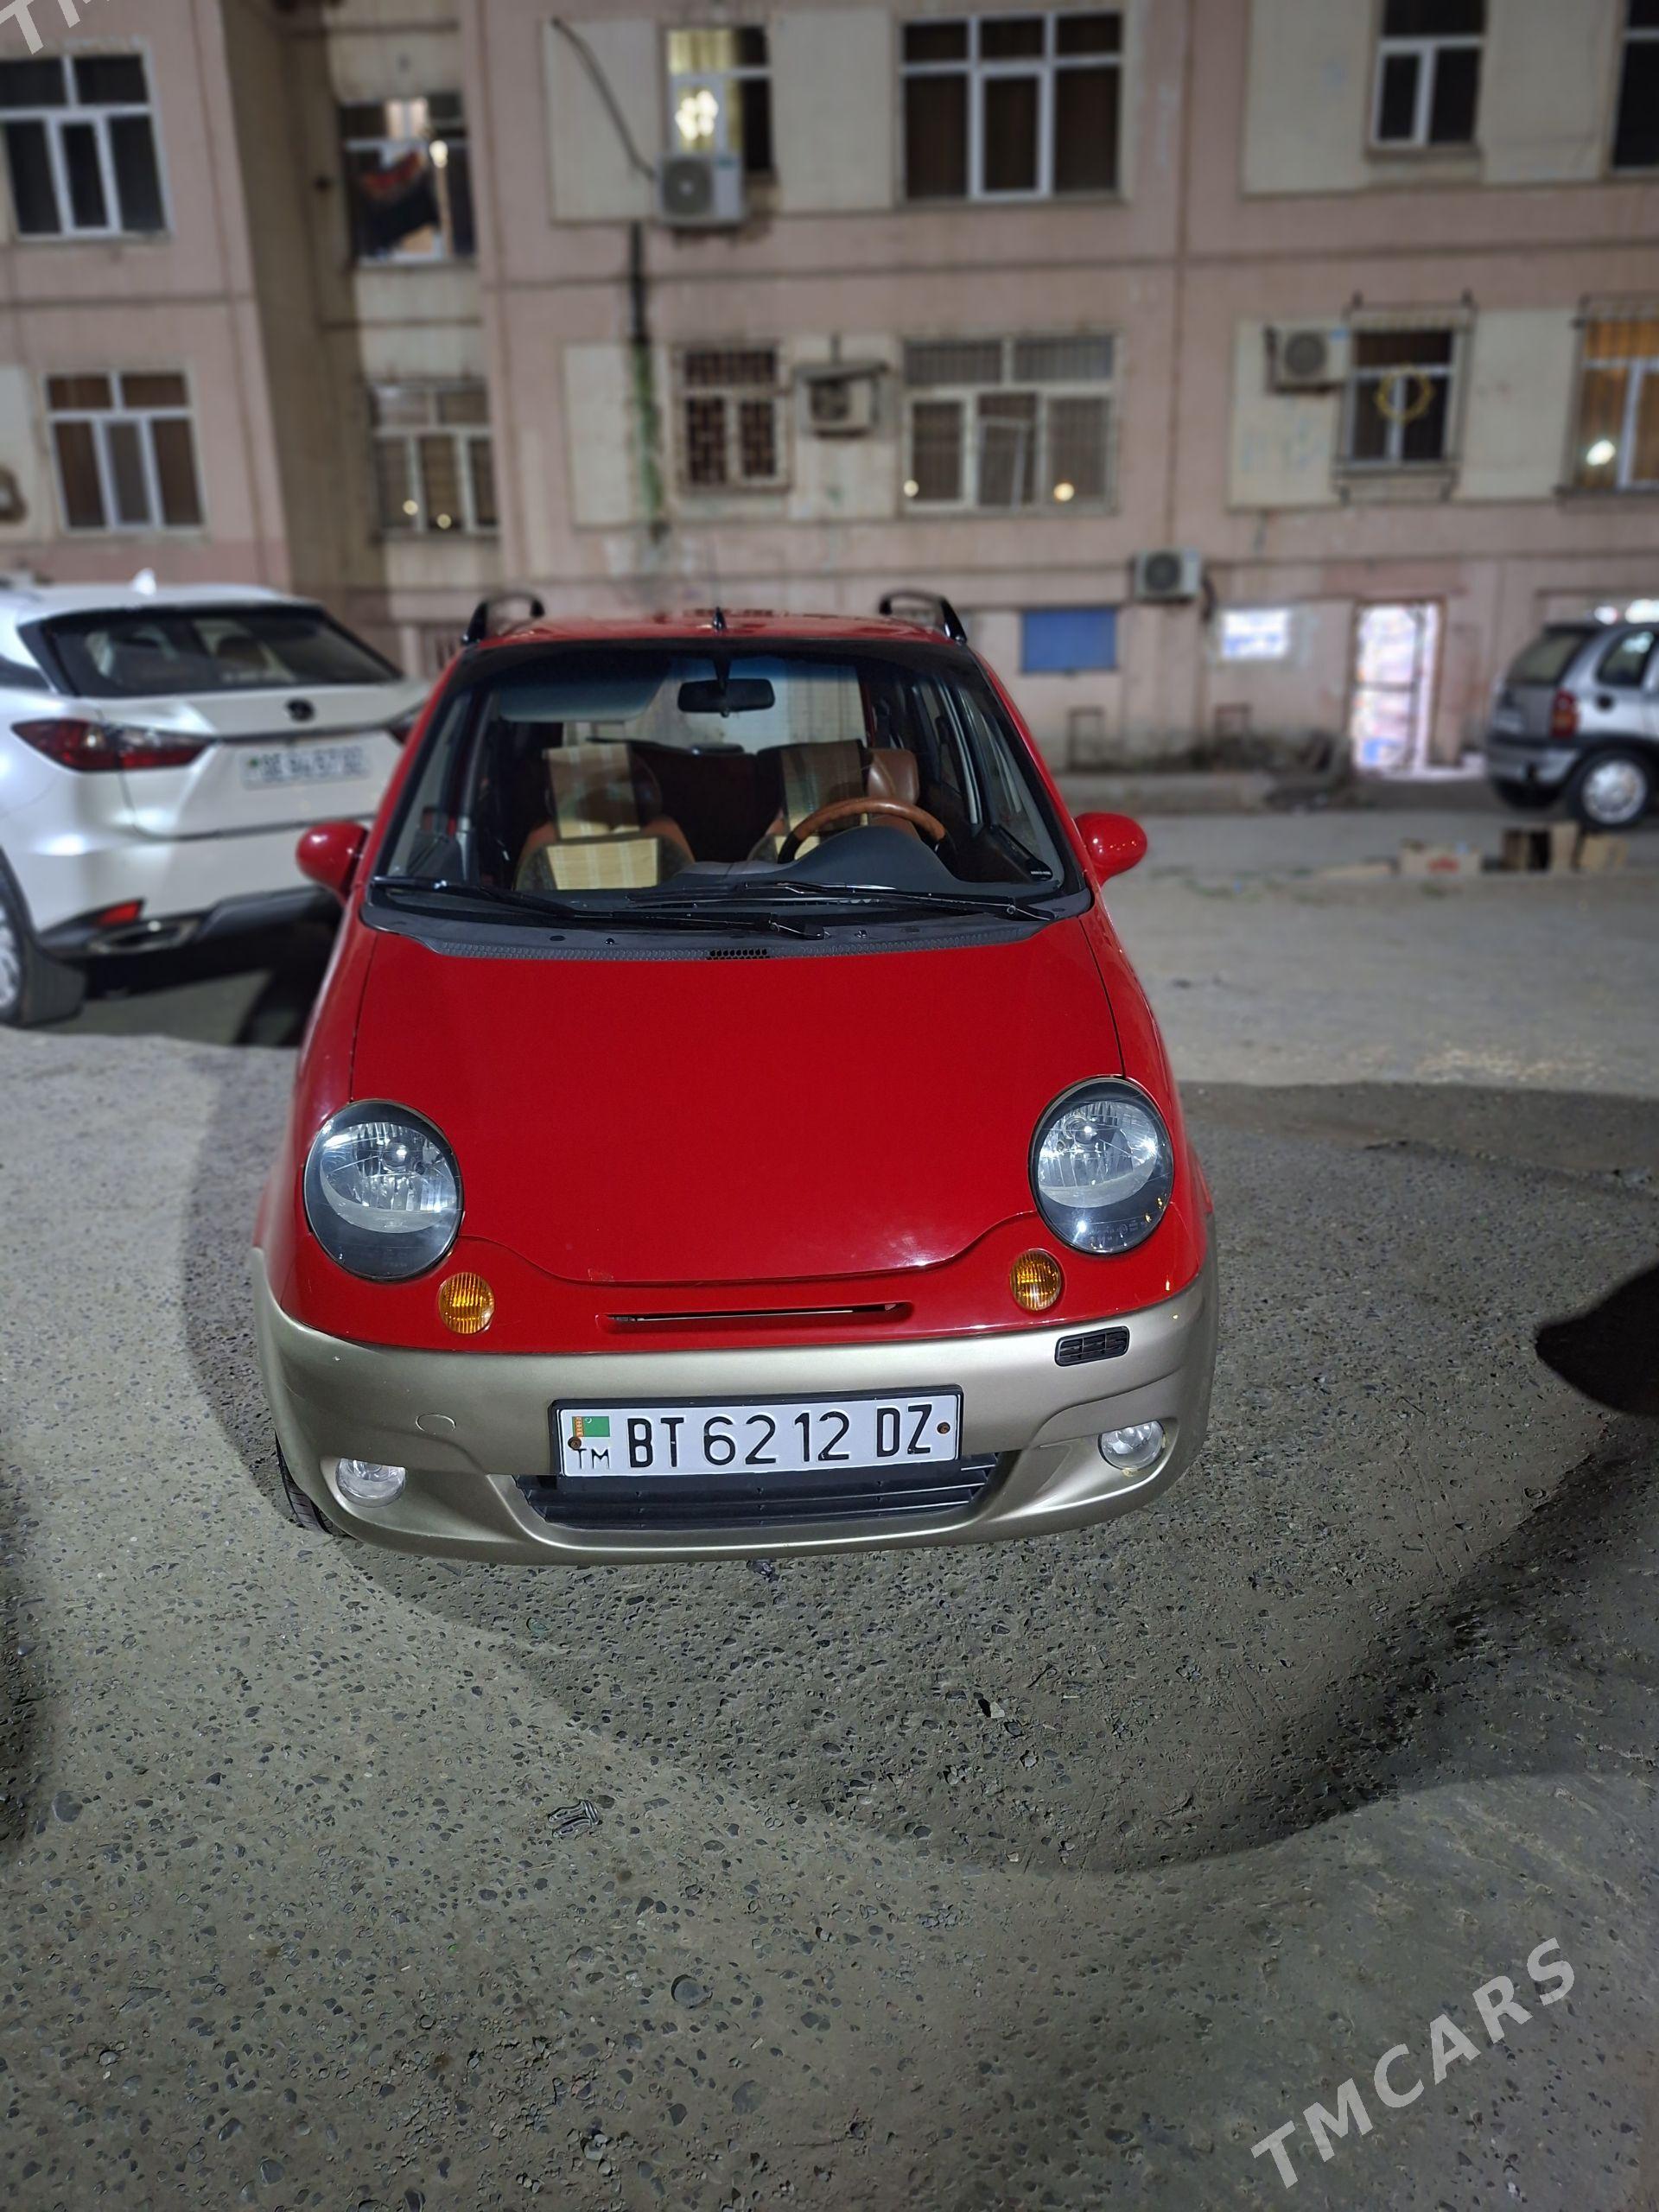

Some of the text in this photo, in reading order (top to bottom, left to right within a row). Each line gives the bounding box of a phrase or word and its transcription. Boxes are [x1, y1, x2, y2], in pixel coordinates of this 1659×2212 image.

[626, 1417, 685, 1468] BT
[876, 1403, 932, 1458] DZ
[571, 1447, 610, 1469] TM
